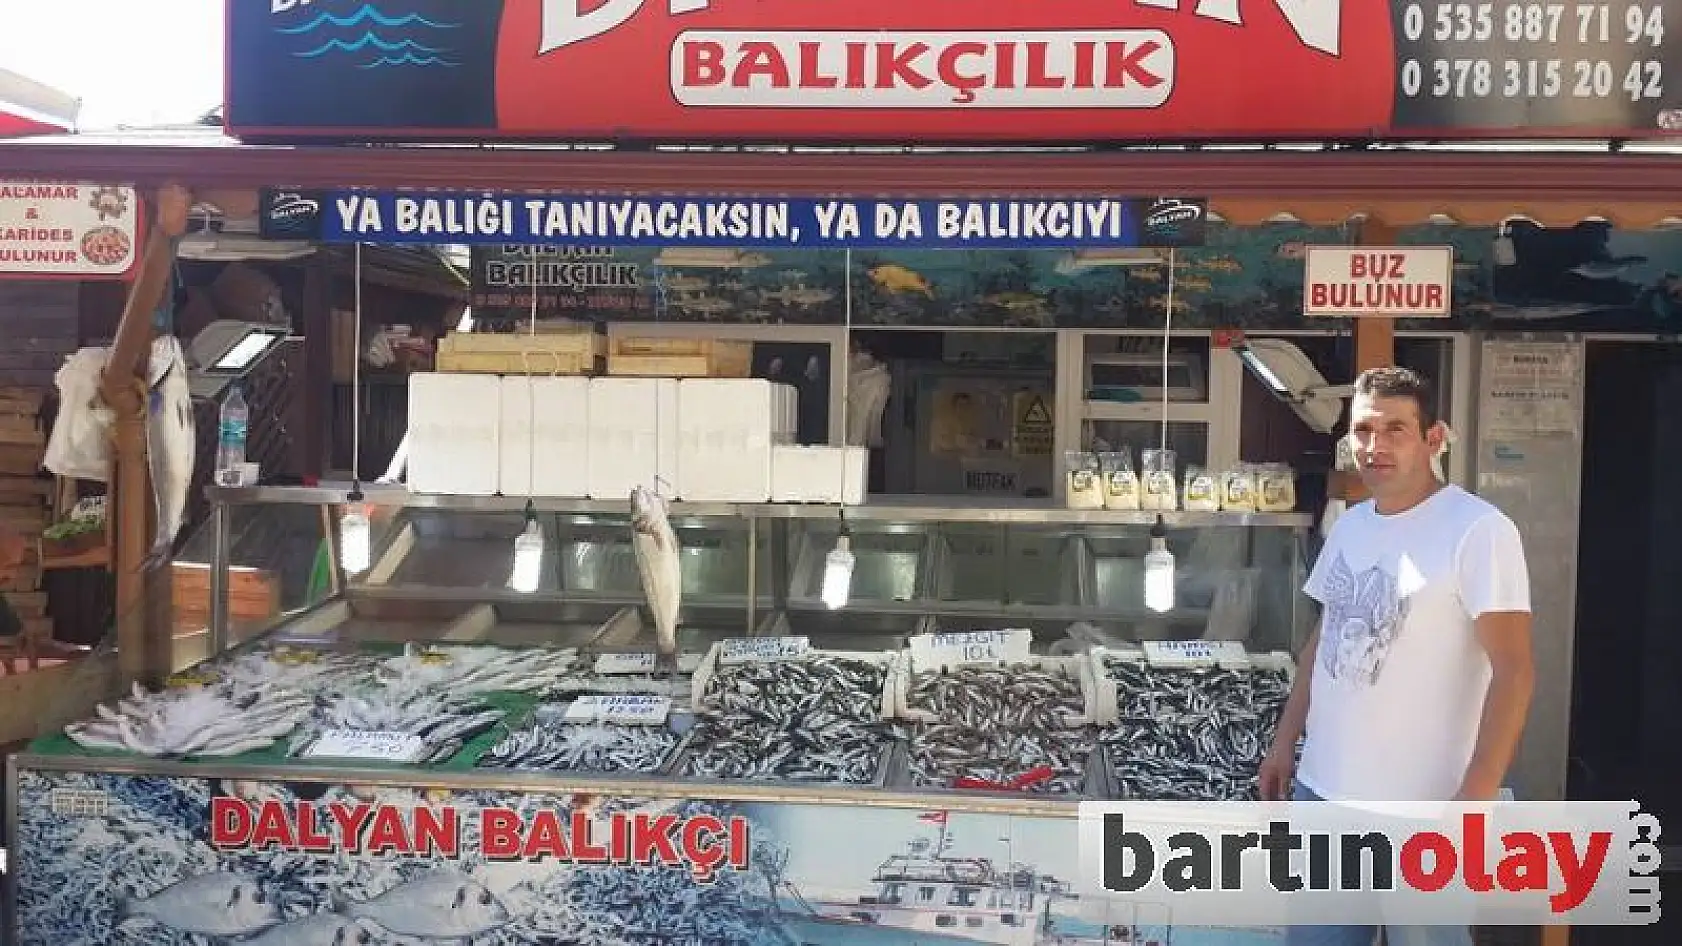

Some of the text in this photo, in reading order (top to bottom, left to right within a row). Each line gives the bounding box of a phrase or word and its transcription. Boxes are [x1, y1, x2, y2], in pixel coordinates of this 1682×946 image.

[1404, 3, 1664, 46] 0 535 887 71 94
[683, 40, 1165, 104] BALIKÇILIK
[1401, 59, 1662, 101] 0 378 315 20 42
[336, 195, 383, 232] YA
[396, 193, 512, 236] BALIĞI
[525, 199, 800, 242] TANIYACAKSIN,
[814, 201, 861, 239] YA
[875, 203, 922, 239] DA
[1350, 253, 1406, 279] BUZ
[1310, 283, 1443, 308] BULUNUR
[211, 796, 751, 885] DALYAN BALIKÇI
